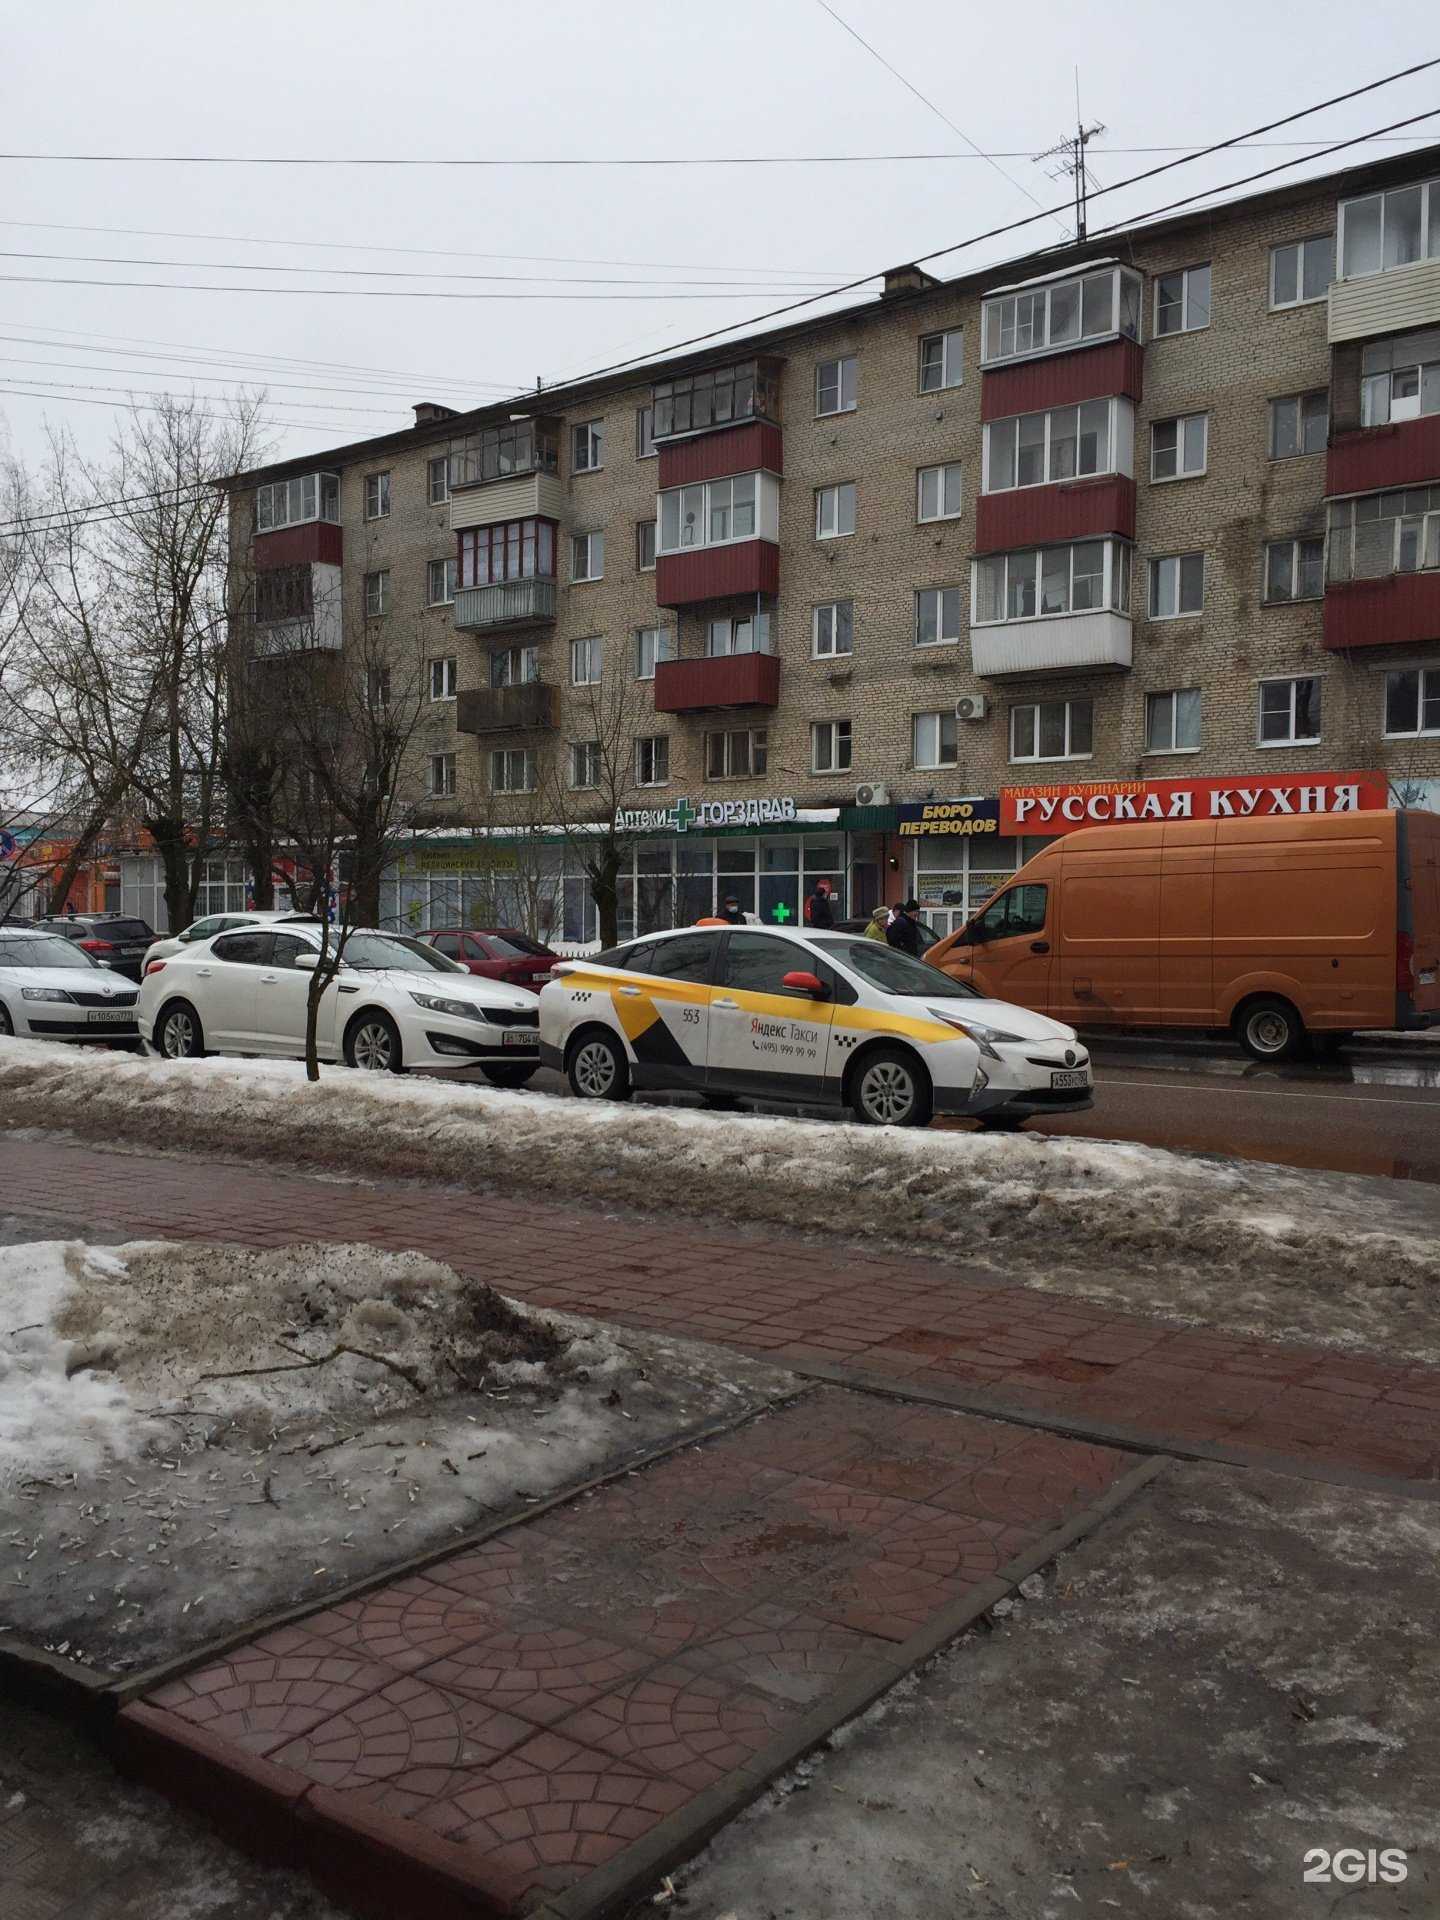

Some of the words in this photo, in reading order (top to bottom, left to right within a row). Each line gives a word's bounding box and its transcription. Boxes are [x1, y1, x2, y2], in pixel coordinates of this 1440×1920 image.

[1004, 785, 1061, 798] МАГАЗИН
[1068, 782, 1146, 797] КУЛИНАРИИ
[922, 804, 974, 819] БЮРО
[1015, 791, 1194, 823] РУССКАЯ
[1208, 784, 1361, 816] КУХНЯ
[615, 806, 668, 829] Аптеки
[700, 797, 798, 827] ГОРЗДРАВ
[899, 819, 998, 836] ПЕРЕВОДОВ
[682, 1008, 700, 1024] 553
[751, 1017, 788, 1039] Яндекс
[790, 1023, 818, 1044] Такси
[760, 1040, 778, 1054] (495)
[780, 1043, 794, 1057] 999
[796, 1046, 805, 1057] 99
[807, 1048, 817, 1059] 99
